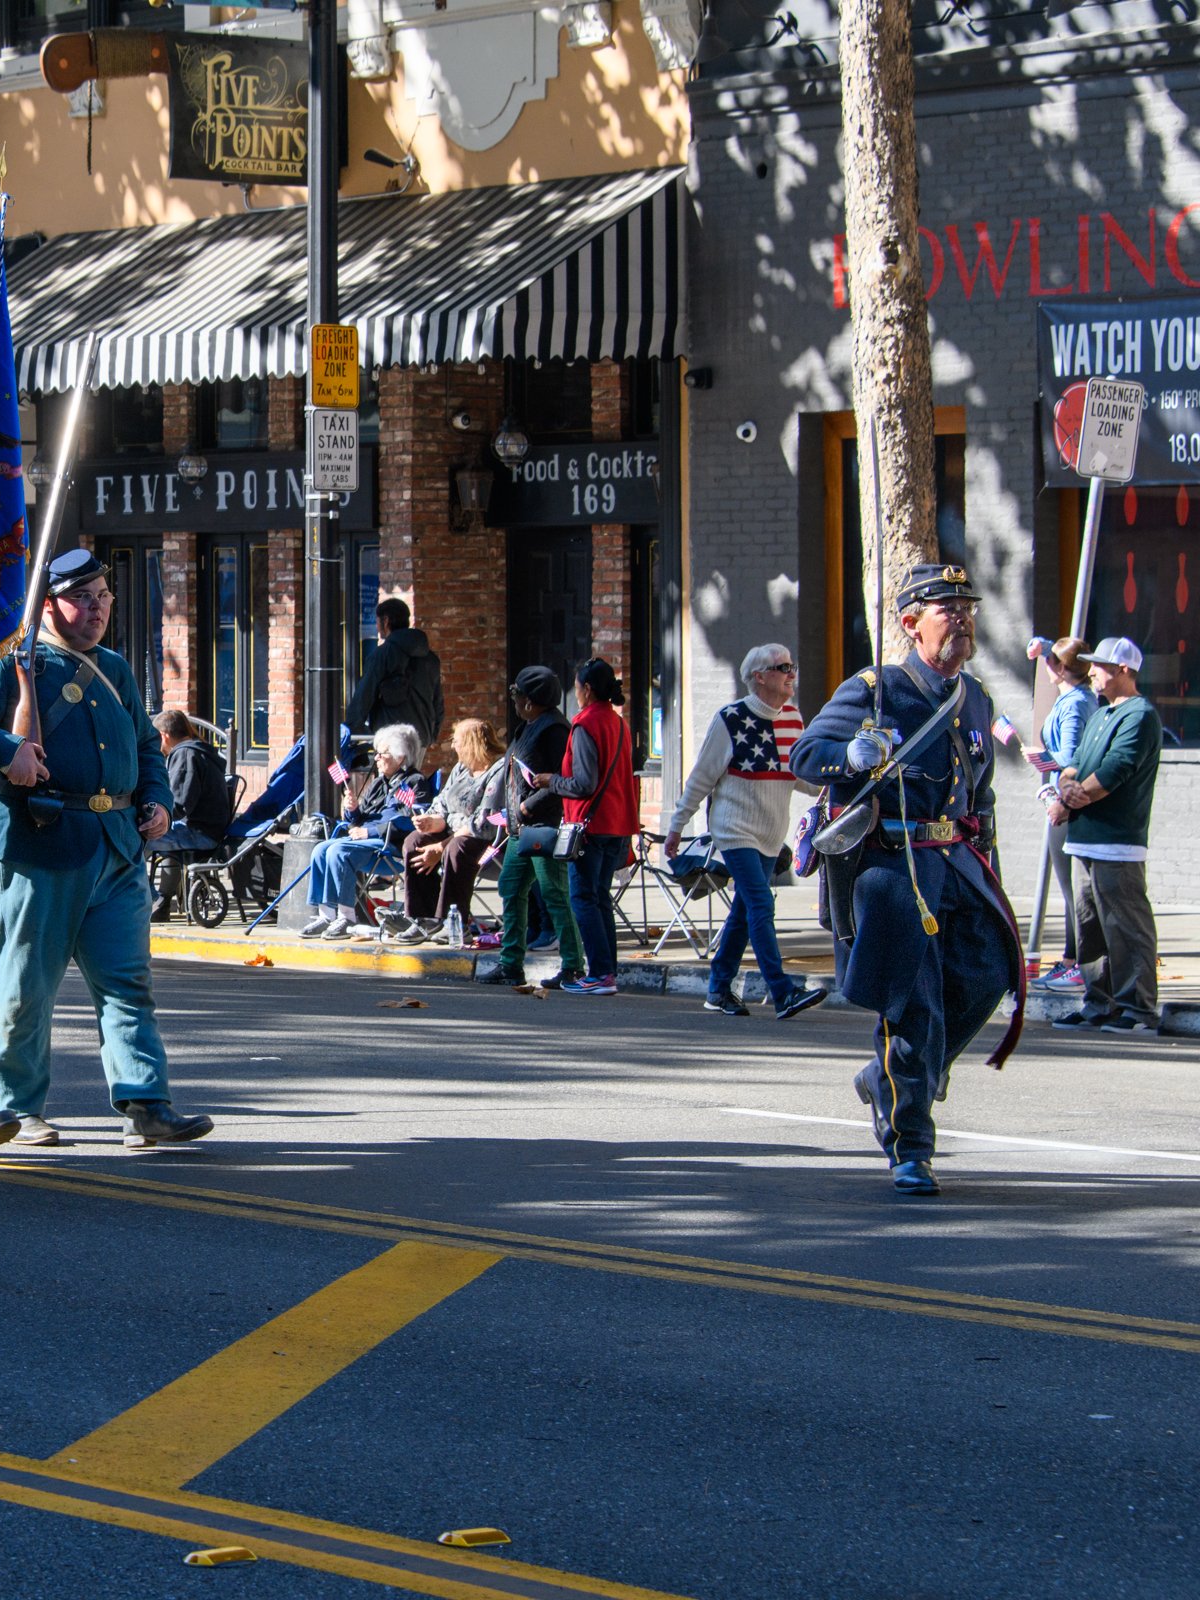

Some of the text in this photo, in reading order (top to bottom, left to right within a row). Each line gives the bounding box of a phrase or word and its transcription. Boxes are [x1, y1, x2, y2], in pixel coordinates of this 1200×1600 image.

[201, 52, 260, 109] FIVE
[209, 107, 307, 169] POINTS
[225, 159, 297, 174] COCKTAIL BAR
[316, 329, 354, 344] FREIGHT
[315, 345, 355, 361] LOADING
[1050, 320, 1142, 377] WATCH
[324, 362, 347, 377] ZONE
[316, 383, 353, 396] 7AM 6PM
[1090, 383, 1140, 404] PASSENGER
[1160, 389, 1183, 410] 150"
[1185, 389, 1200, 409] PR
[1090, 403, 1135, 421] LOADING
[322, 416, 349, 431] TAXI
[1097, 420, 1124, 438] ZONE
[318, 435, 355, 449] STAND
[318, 453, 332, 461] 11PM
[339, 453, 353, 461] 4AM
[321, 464, 351, 473] MAXIMUM
[567, 458, 580, 480] &
[331, 474, 349, 483] CABS
[95, 468, 350, 515] FIVE POIN
[571, 483, 616, 516] 169
